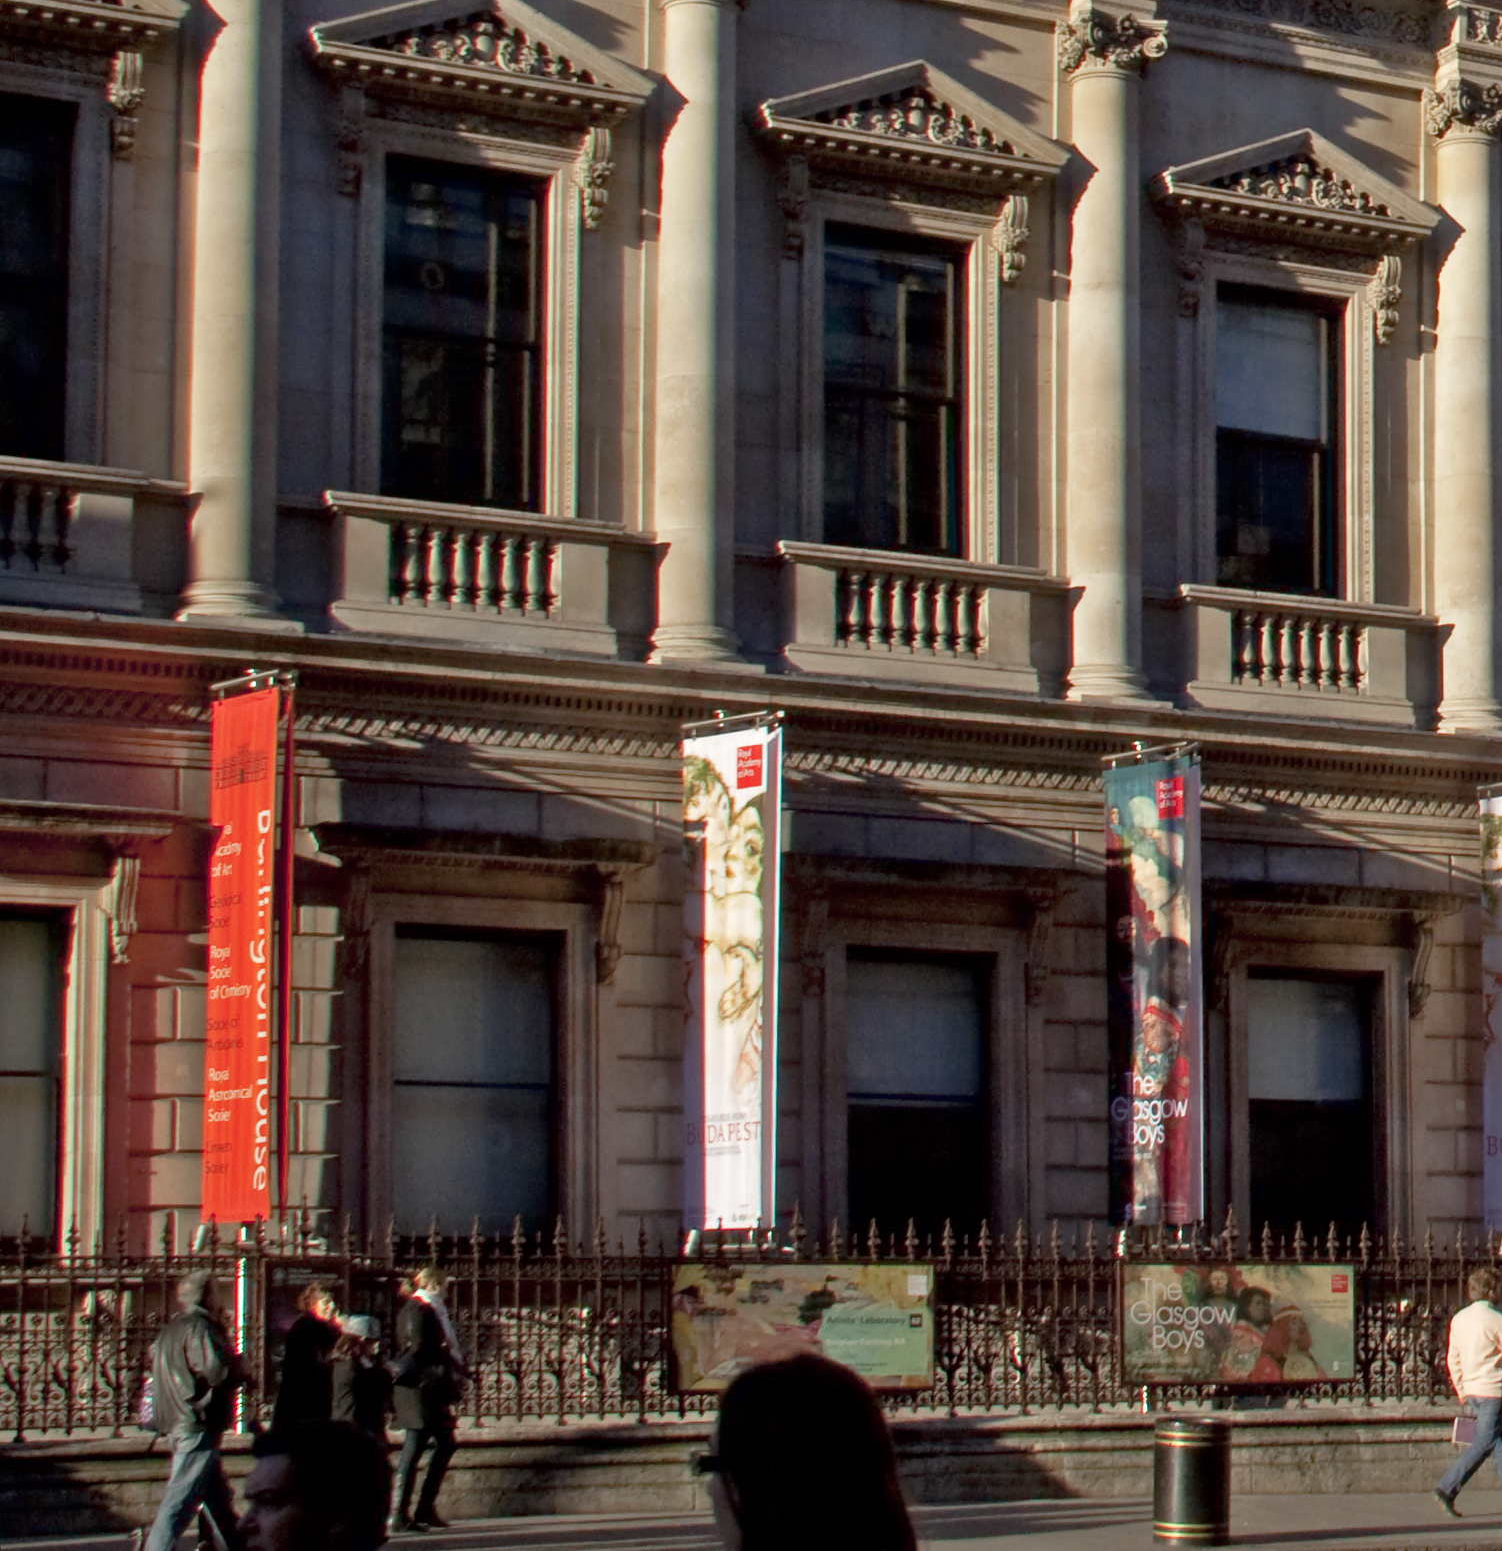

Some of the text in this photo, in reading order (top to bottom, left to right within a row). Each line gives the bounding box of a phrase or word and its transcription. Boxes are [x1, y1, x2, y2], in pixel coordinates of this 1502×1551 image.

[1125, 1071, 1155, 1095] The
[1111, 1096, 1188, 1126] Glasgow
[686, 1120, 761, 1147] BUDAPEST
[1128, 1120, 1165, 1150] Boys
[1140, 1277, 1183, 1301] The
[860, 1316, 906, 1326] Laboratory
[1130, 1301, 1236, 1330] Glasgow
[1152, 1325, 1205, 1354] Boys
